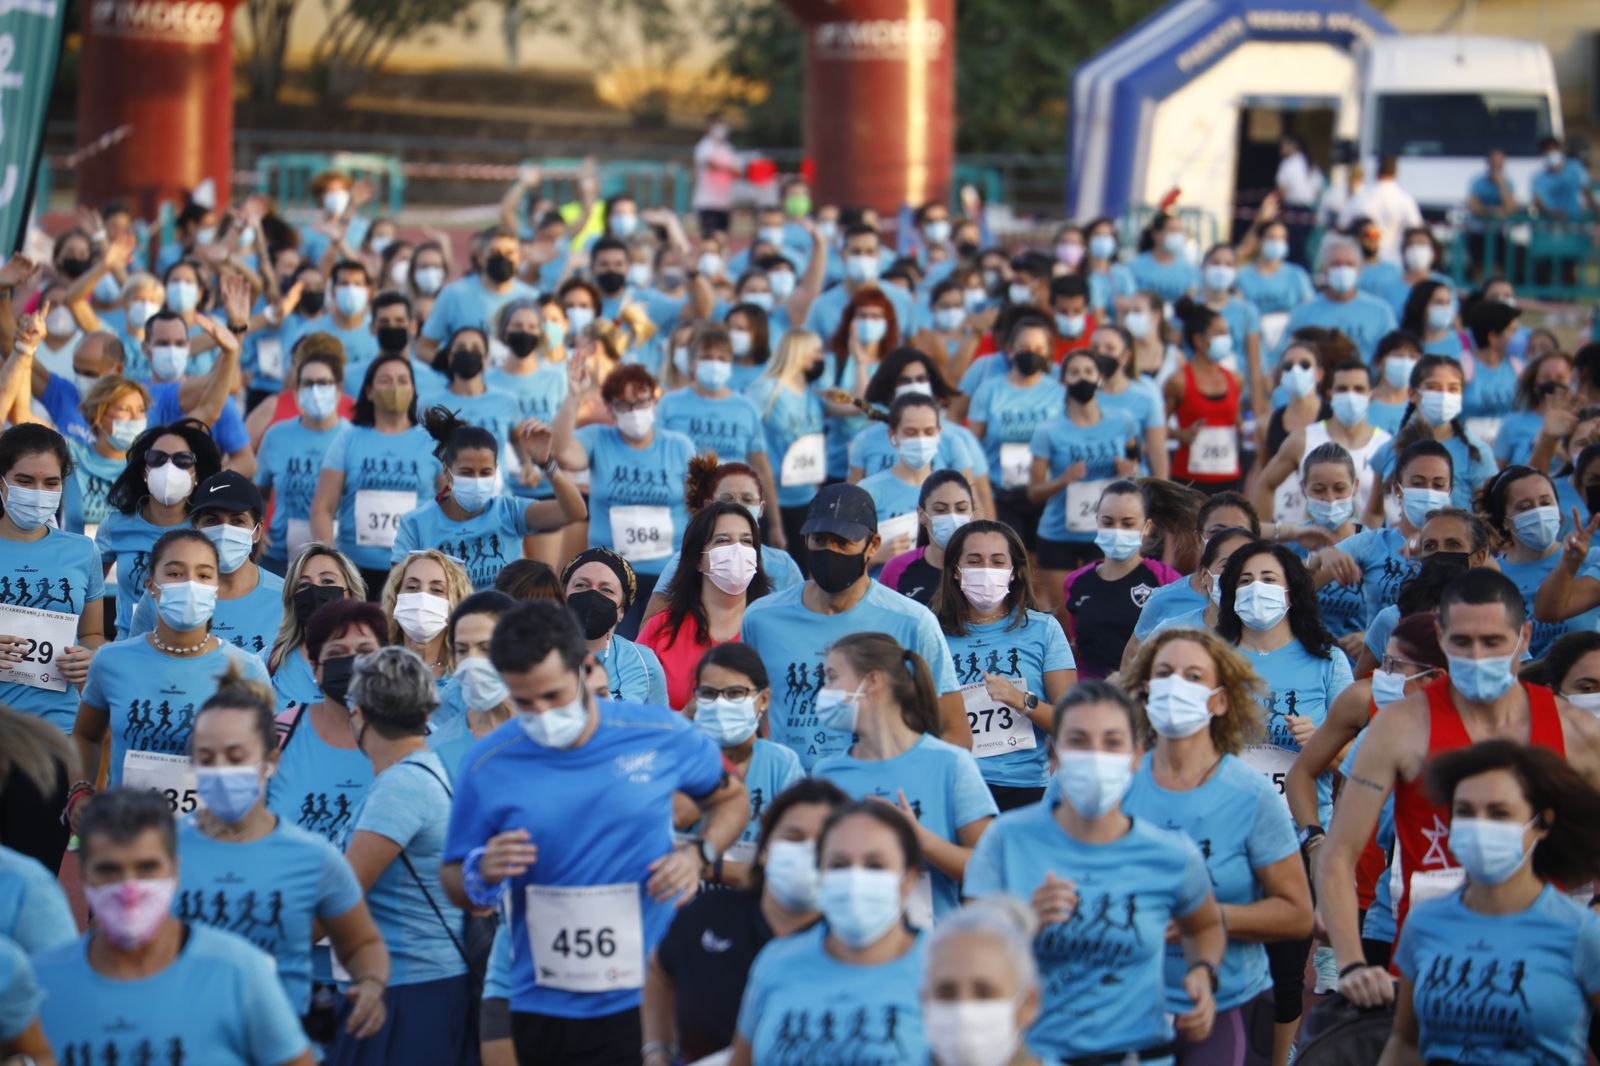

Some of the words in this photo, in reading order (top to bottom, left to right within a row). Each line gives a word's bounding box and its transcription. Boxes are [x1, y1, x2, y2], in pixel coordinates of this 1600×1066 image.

[626, 527, 659, 544] 368
[966, 706, 1014, 734] 273
[552, 927, 616, 958] 456
